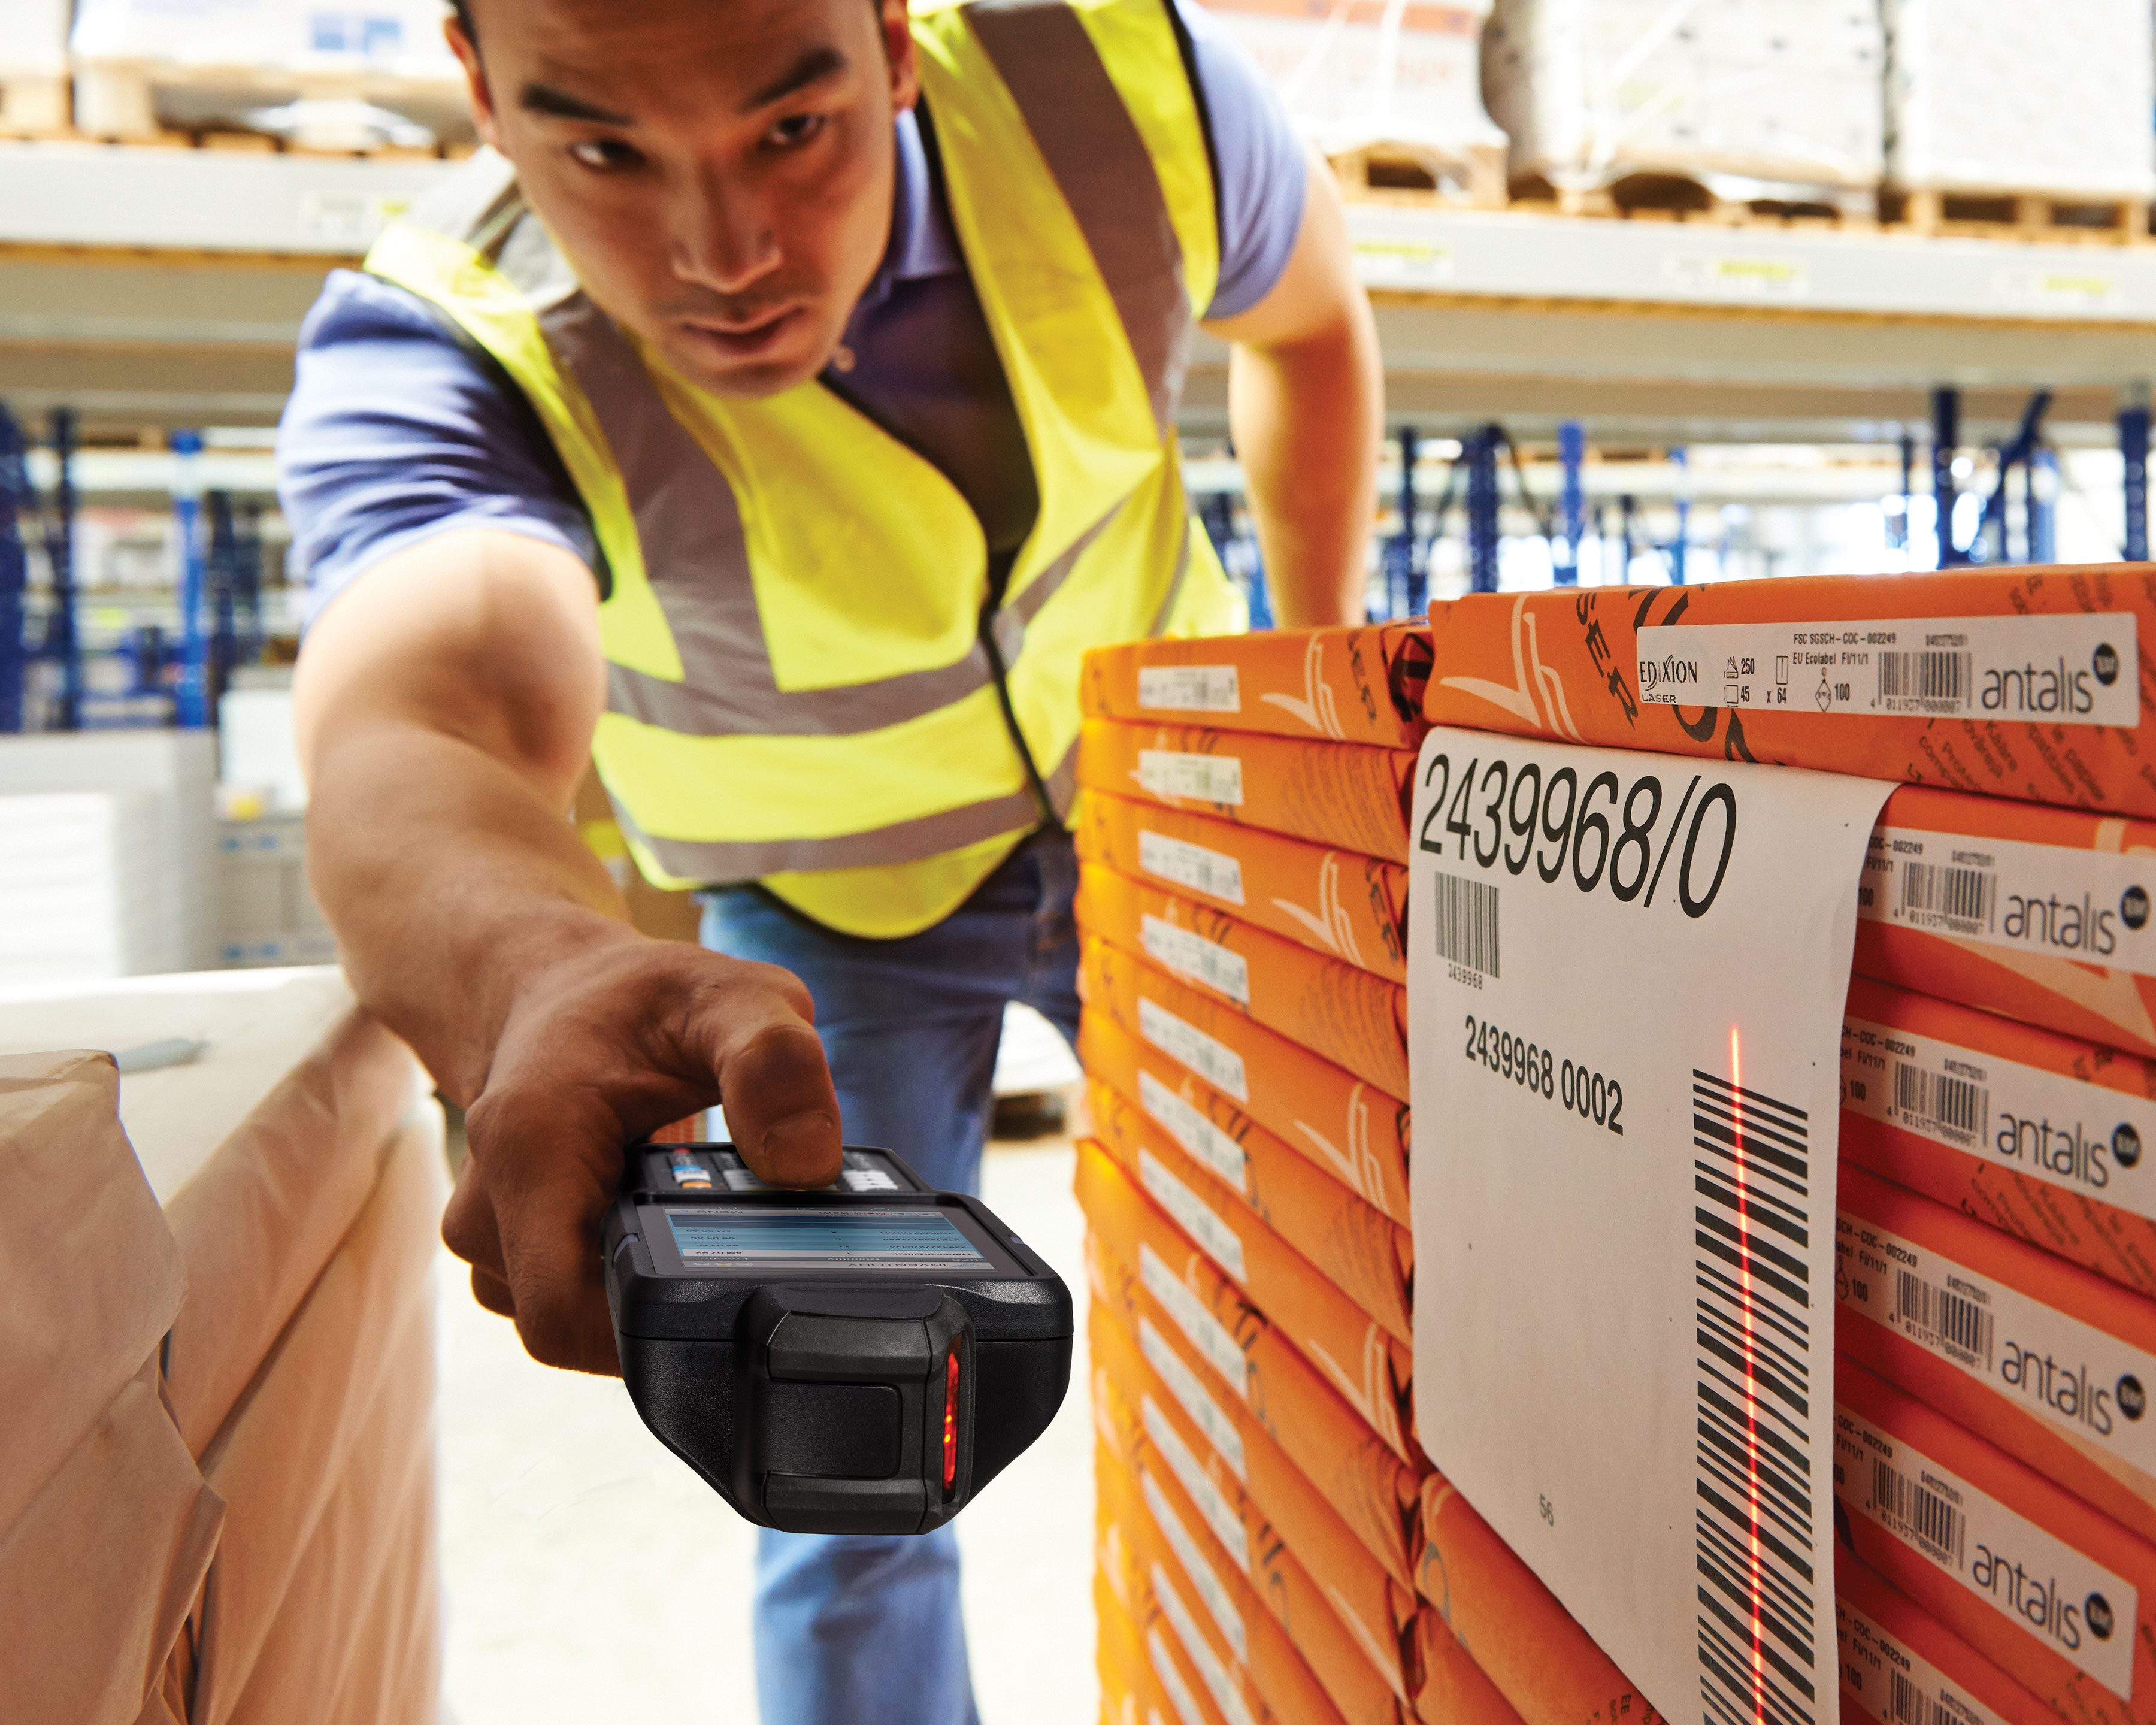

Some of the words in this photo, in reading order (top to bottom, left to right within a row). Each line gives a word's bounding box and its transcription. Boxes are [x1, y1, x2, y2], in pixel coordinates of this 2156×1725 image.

[1794, 633, 1807, 644] FSC
[1741, 658, 1755, 675] 250
[1793, 652, 1803, 664] EU
[1806, 652, 1836, 665] Ecolabel
[1741, 686, 1750, 702] 45
[1777, 687, 1786, 704] 64
[1834, 683, 1850, 701] 100
[1981, 655, 2094, 715] antalis
[1642, 694, 1677, 703] LASER
[1420, 754, 1737, 918] 2439968/0
[2004, 891, 2116, 955] antalis
[1449, 963, 1483, 990] 2439968
[1465, 1015, 1554, 1100] 2439968
[1561, 1059, 1623, 1136] 0002
[1850, 1079, 1866, 1101] 100
[1997, 1113, 2109, 1189] antalis
[1852, 1279, 1868, 1302] 100
[2002, 1340, 2112, 1436] antalis
[1539, 1491, 1554, 1527] 56
[1973, 1544, 2081, 1651] antalis
[1846, 1664, 1861, 1690] 100
